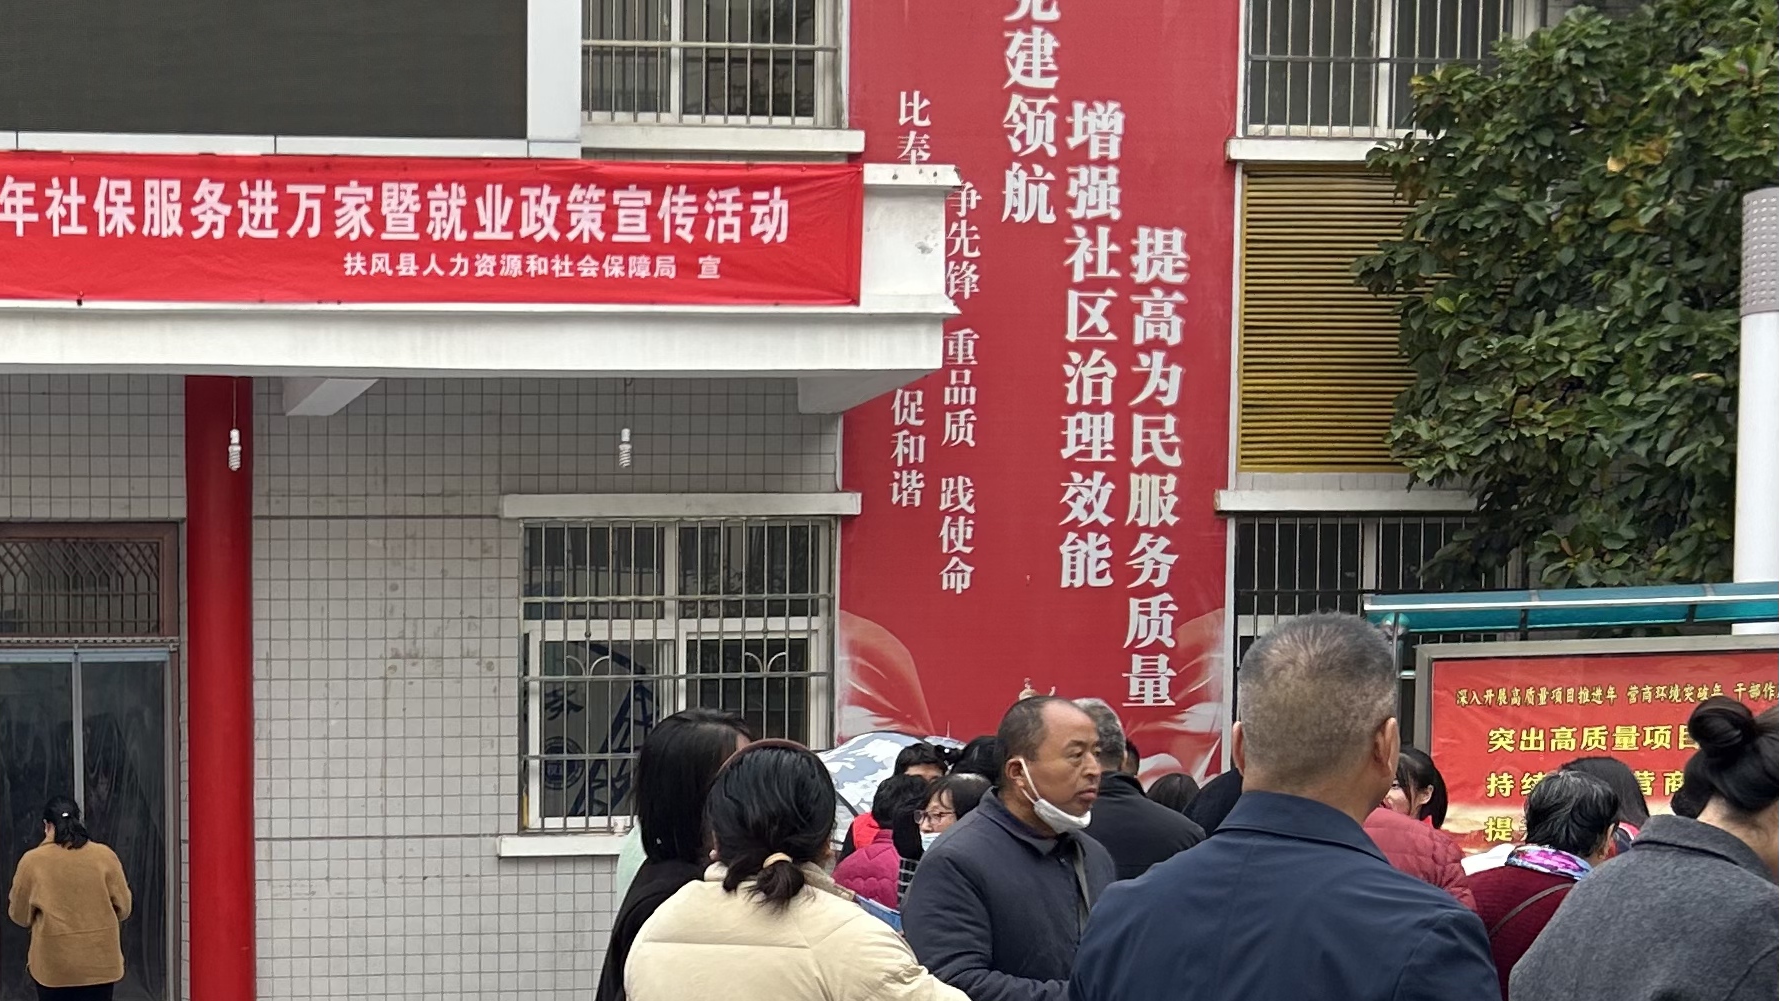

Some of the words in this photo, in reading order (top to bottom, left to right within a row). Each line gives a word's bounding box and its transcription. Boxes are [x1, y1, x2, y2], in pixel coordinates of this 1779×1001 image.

[343, 252, 677, 279] 扶风县人力资源和社会保障局
[697, 256, 721, 280] 宣
[945, 181, 982, 300] 争先锋
[942, 328, 980, 448] 重品质
[1059, 101, 1125, 588] 增强社区治理效能
[889, 388, 926, 508] 促和谐
[1122, 227, 1190, 708] 提高为民服务质量
[939, 476, 976, 594] 践使命
[1455, 686, 1618, 707] 深入开展高质量项目推进年
[1734, 682, 1779, 702] 干部作
